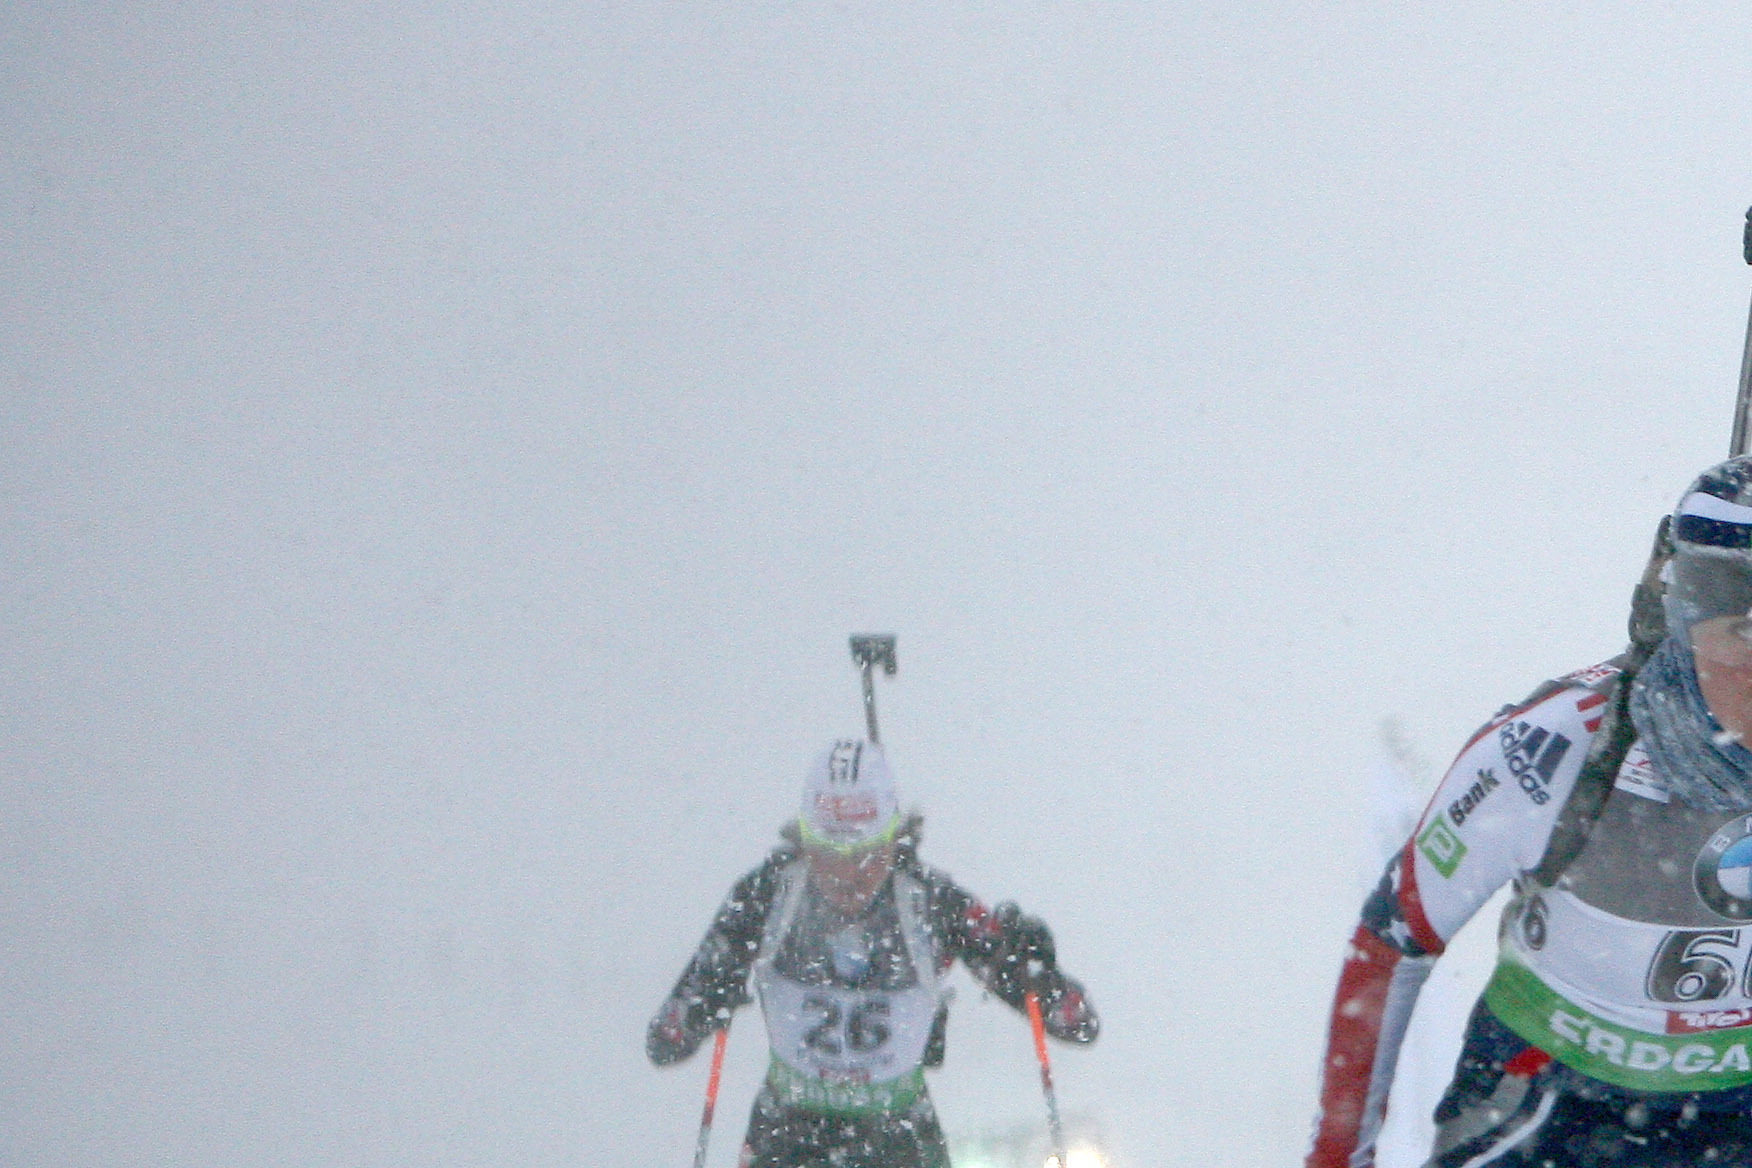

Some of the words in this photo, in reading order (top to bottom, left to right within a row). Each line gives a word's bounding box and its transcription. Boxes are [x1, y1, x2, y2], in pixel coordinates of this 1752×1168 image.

[1499, 721, 1550, 805] adidas
[1447, 767, 1500, 827] Bank
[802, 996, 892, 1054] 26
